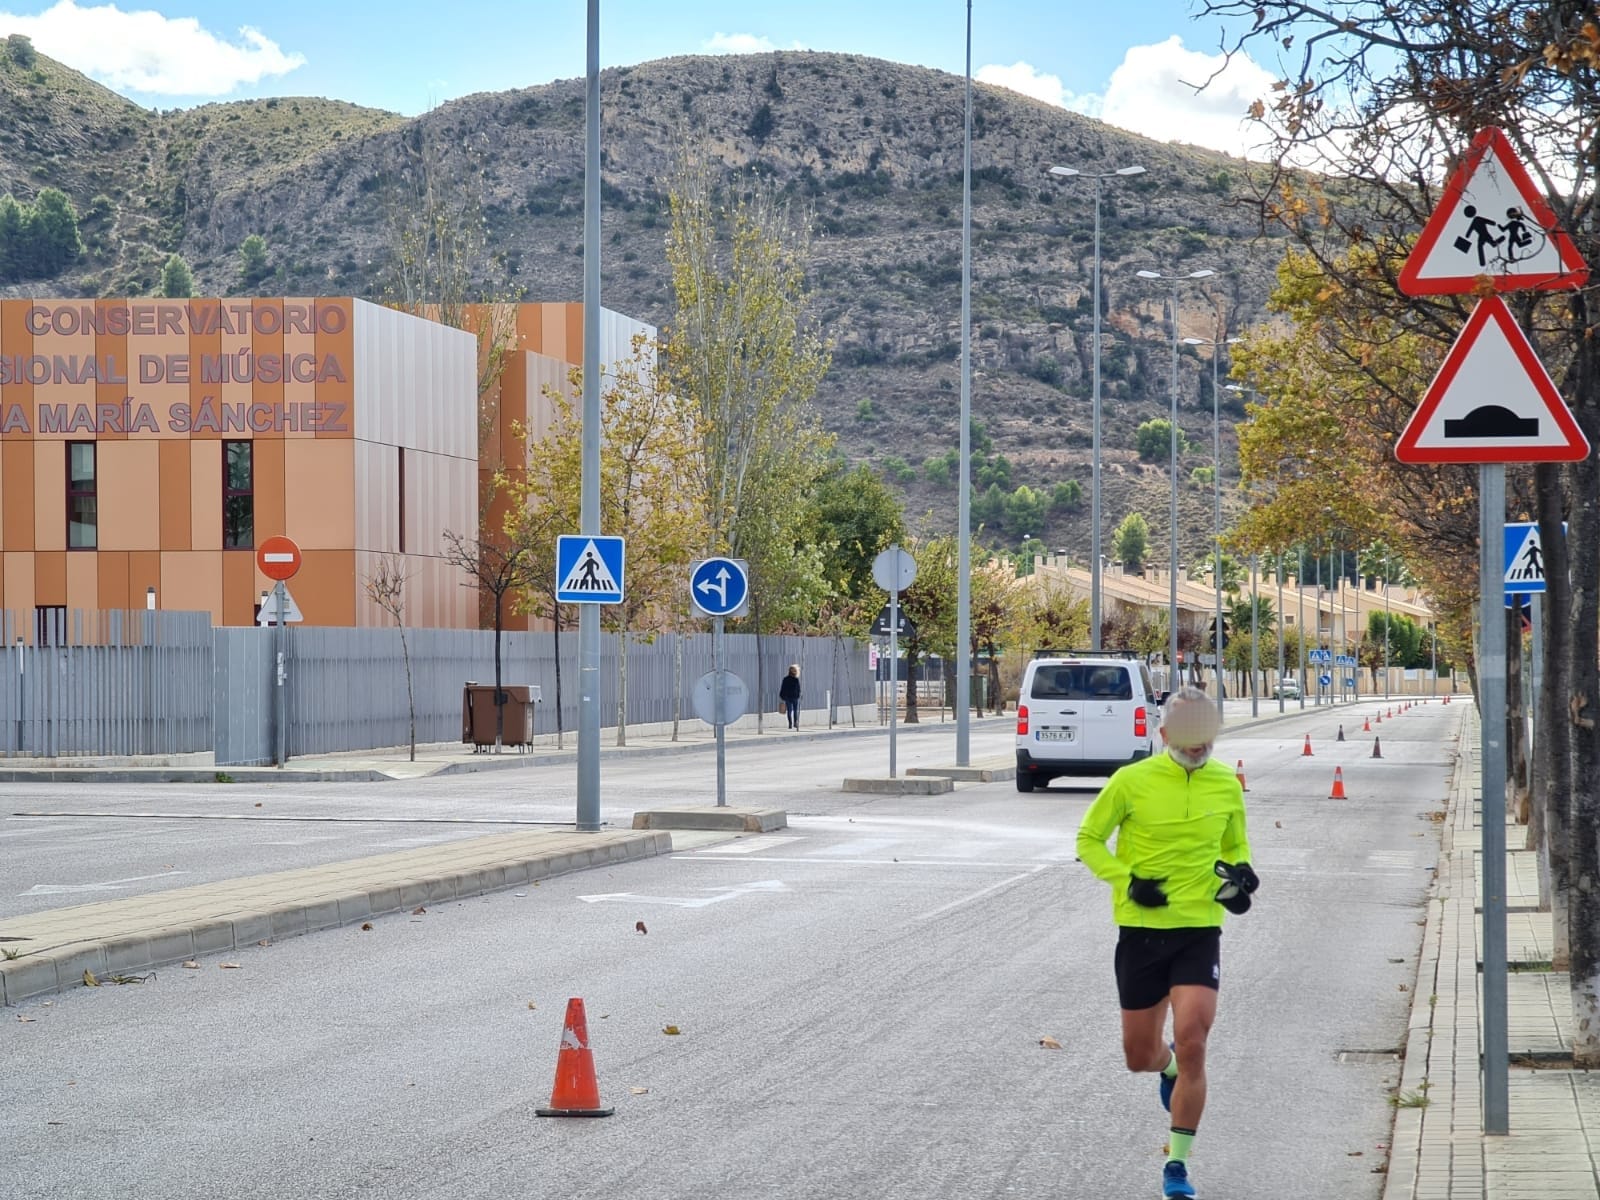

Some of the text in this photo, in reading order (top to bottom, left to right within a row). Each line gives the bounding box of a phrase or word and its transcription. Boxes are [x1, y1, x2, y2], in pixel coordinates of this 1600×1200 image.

[25, 304, 347, 335] CONSERVATORIO
[139, 354, 190, 384] DE
[201, 347, 347, 384] MÚSICA
[0, 396, 348, 433] A MARÍA SÁNCHEZ
